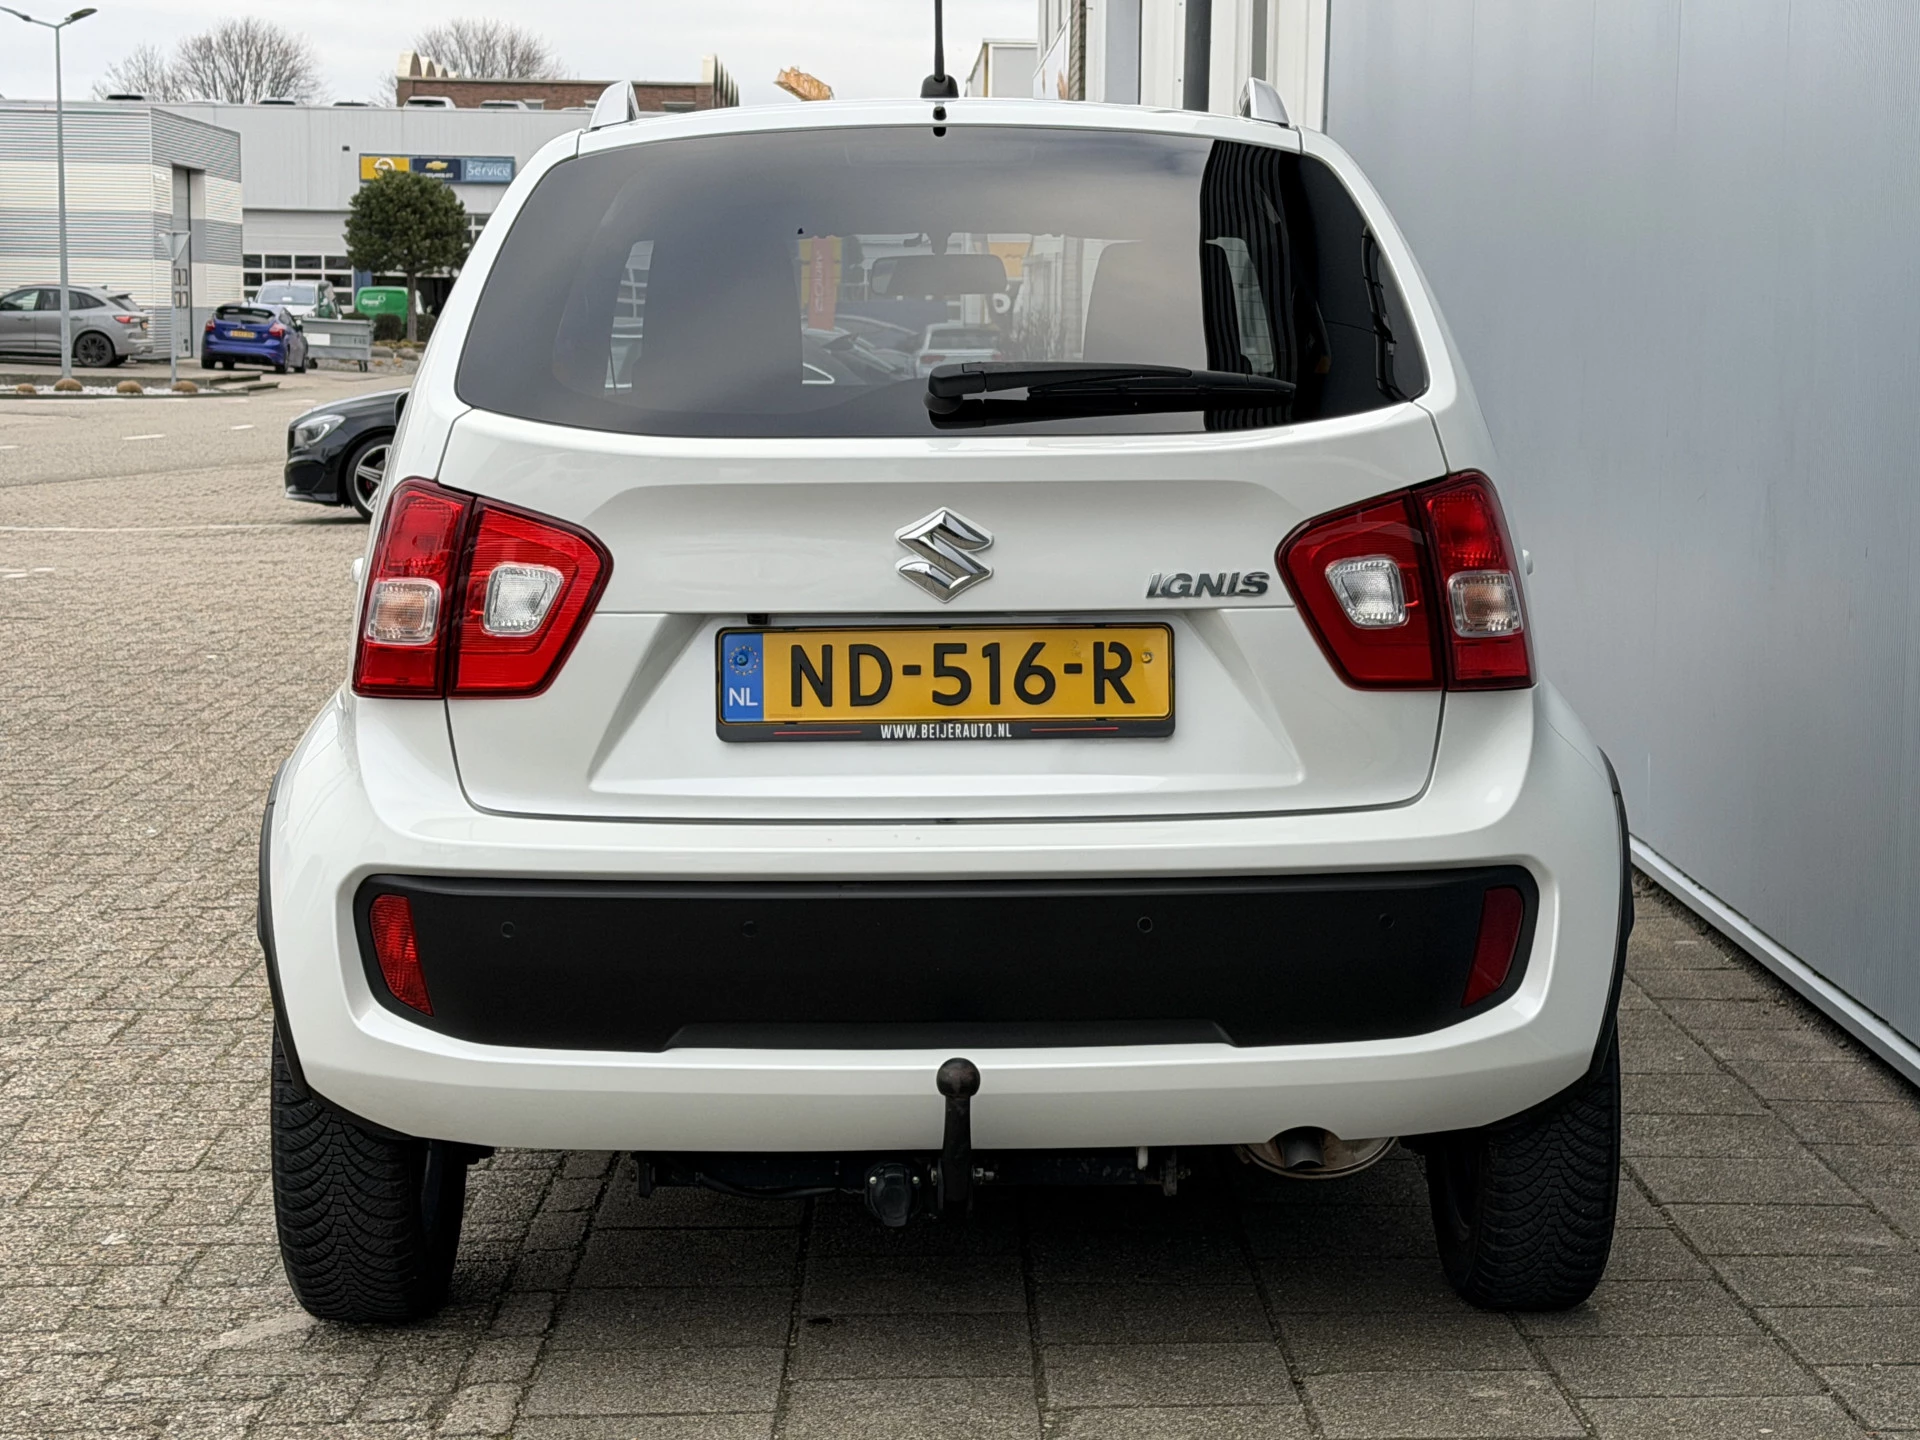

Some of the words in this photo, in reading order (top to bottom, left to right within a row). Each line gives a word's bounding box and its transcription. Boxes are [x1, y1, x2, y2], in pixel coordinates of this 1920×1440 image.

[467, 162, 511, 177] Service
[1146, 571, 1270, 599] IGNIS
[790, 641, 1136, 708] ND-516-R
[728, 687, 759, 707] NL
[880, 723, 1013, 739] WWW.BEIJERAUTO.NL
